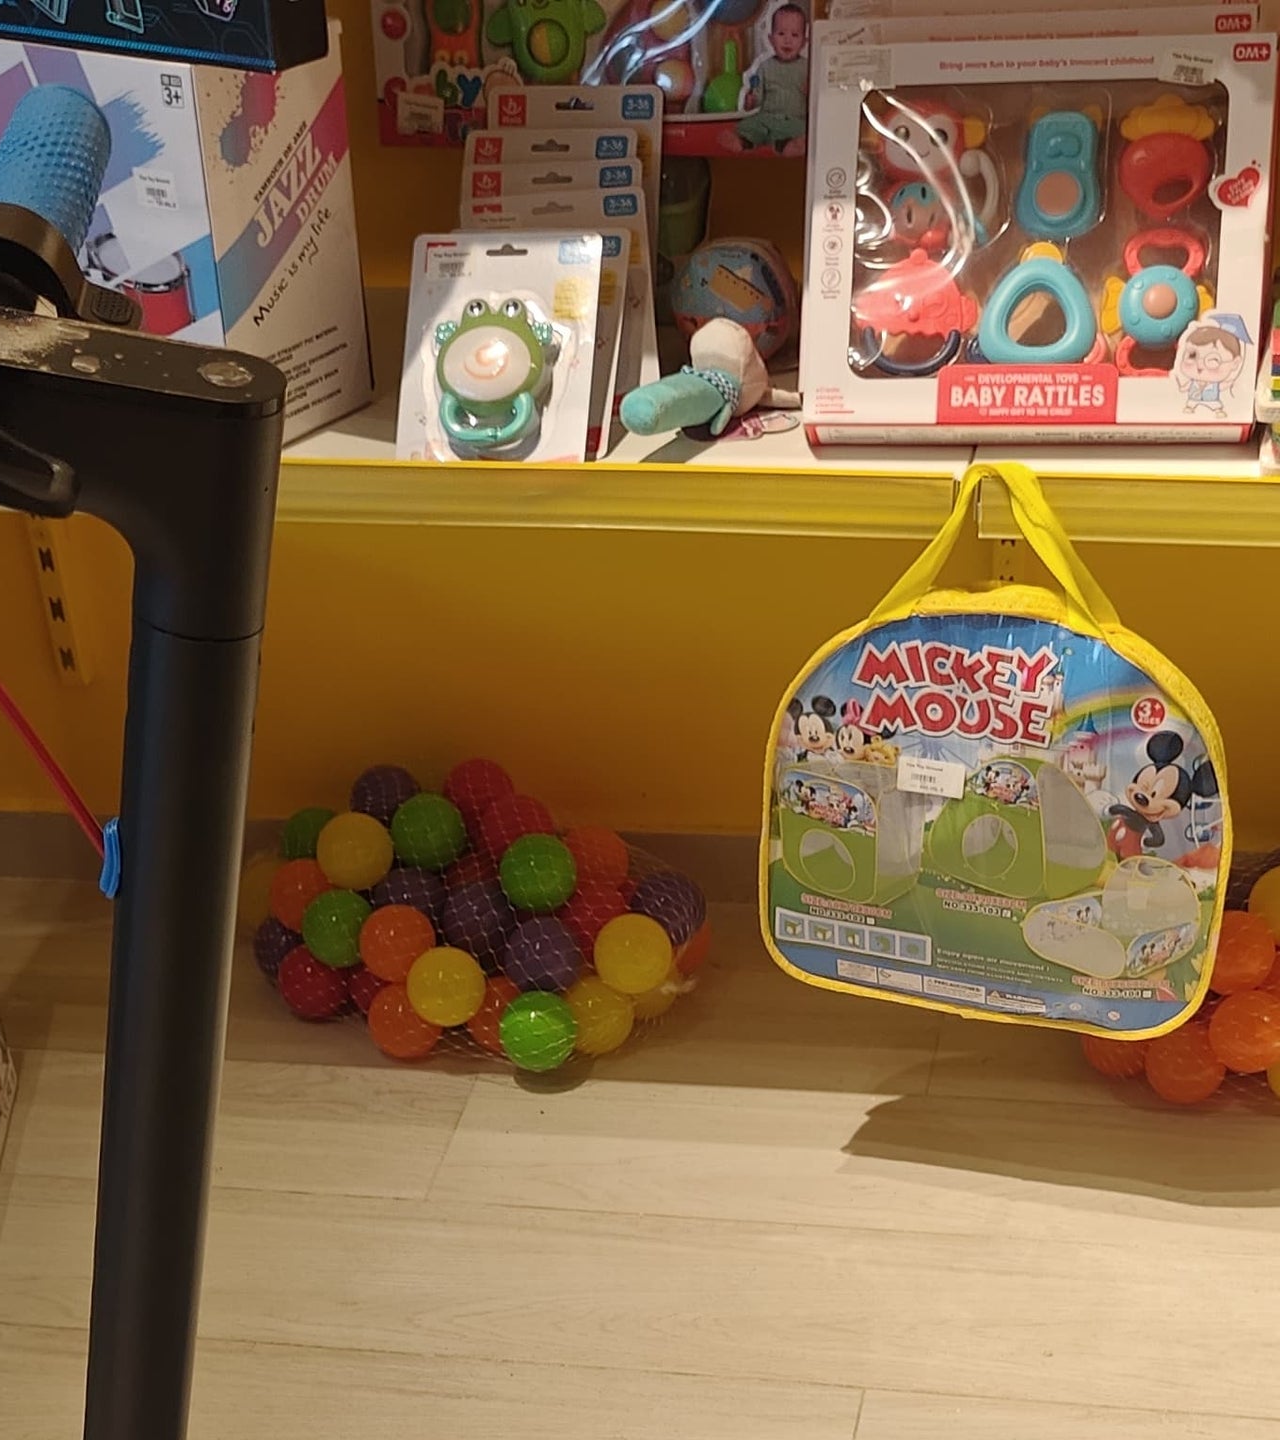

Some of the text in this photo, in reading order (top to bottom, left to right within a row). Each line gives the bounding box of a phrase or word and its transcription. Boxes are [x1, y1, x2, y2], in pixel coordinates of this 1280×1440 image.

[163, 87, 182, 105] 3+
[254, 131, 322, 248] JAZZ
[296, 151, 340, 225] DRUM
[253, 277, 289, 327] Music
[298, 236, 320, 266] my
[311, 207, 332, 237] life
[950, 385, 1105, 407] BABY RATTLES
[853, 641, 1059, 700] MICKEY
[860, 690, 1053, 748] MOUSE
